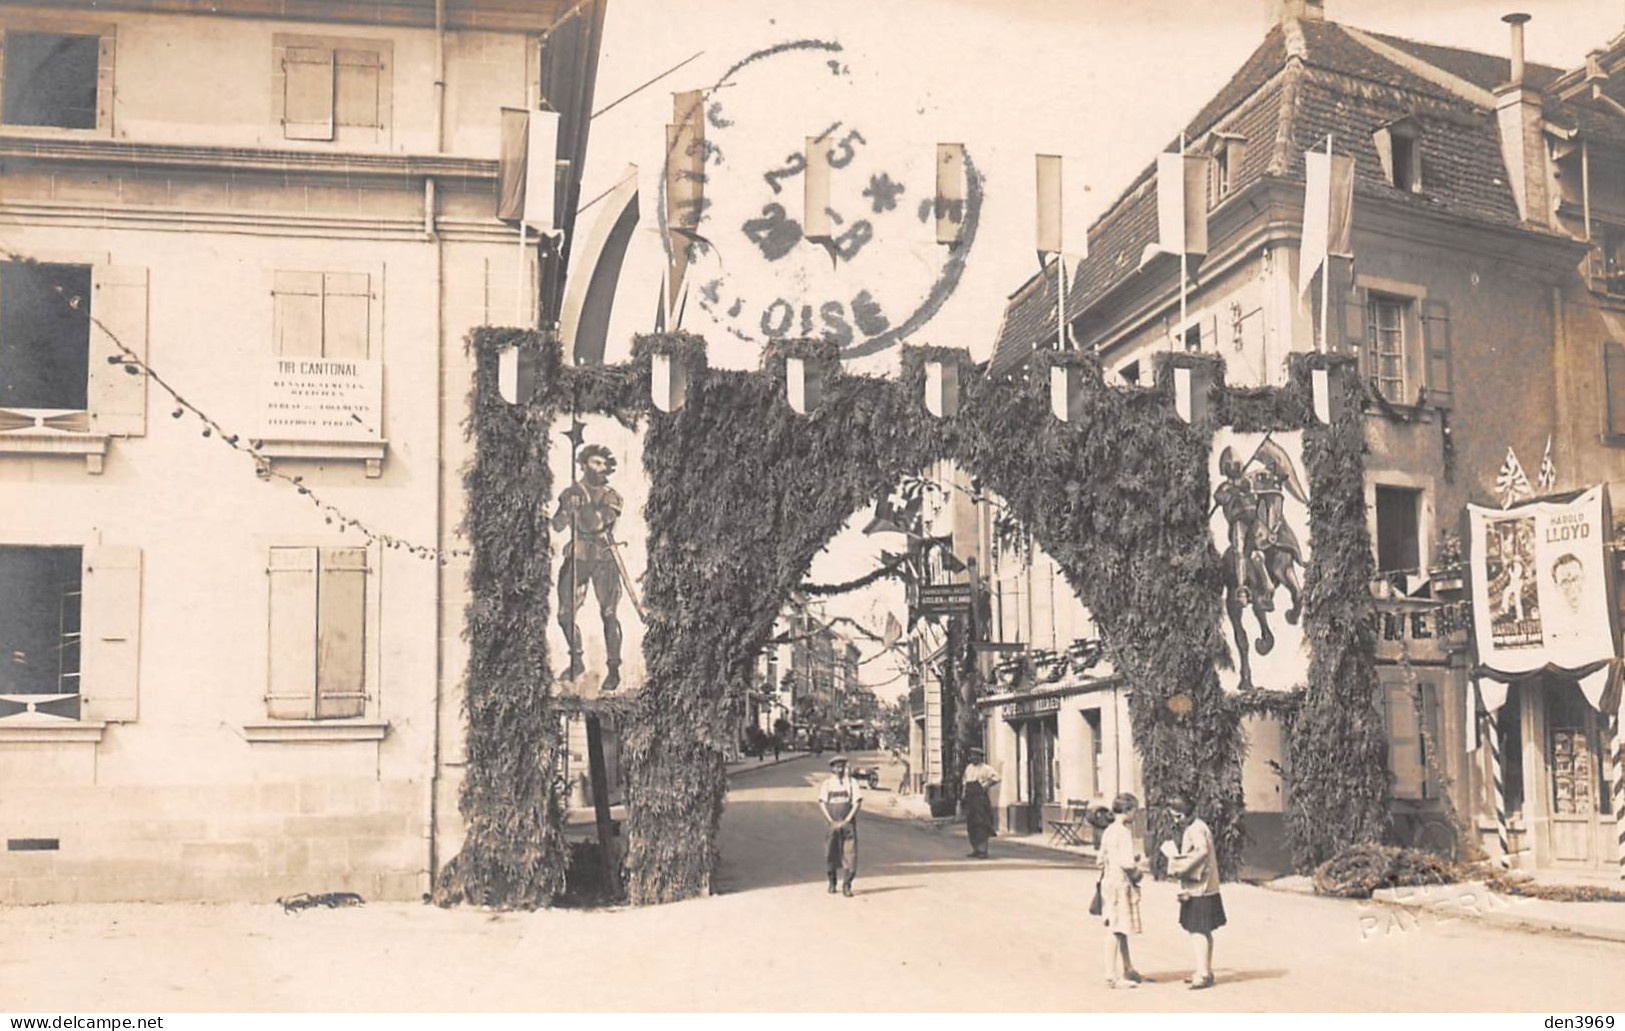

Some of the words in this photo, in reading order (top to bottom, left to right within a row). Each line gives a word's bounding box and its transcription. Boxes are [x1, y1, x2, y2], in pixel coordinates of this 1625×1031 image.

[278, 361, 296, 374] TIR
[300, 362, 357, 377] CANTONAL
[1550, 513, 1585, 525] HAROLD
[1546, 523, 1590, 543] LLOYD
